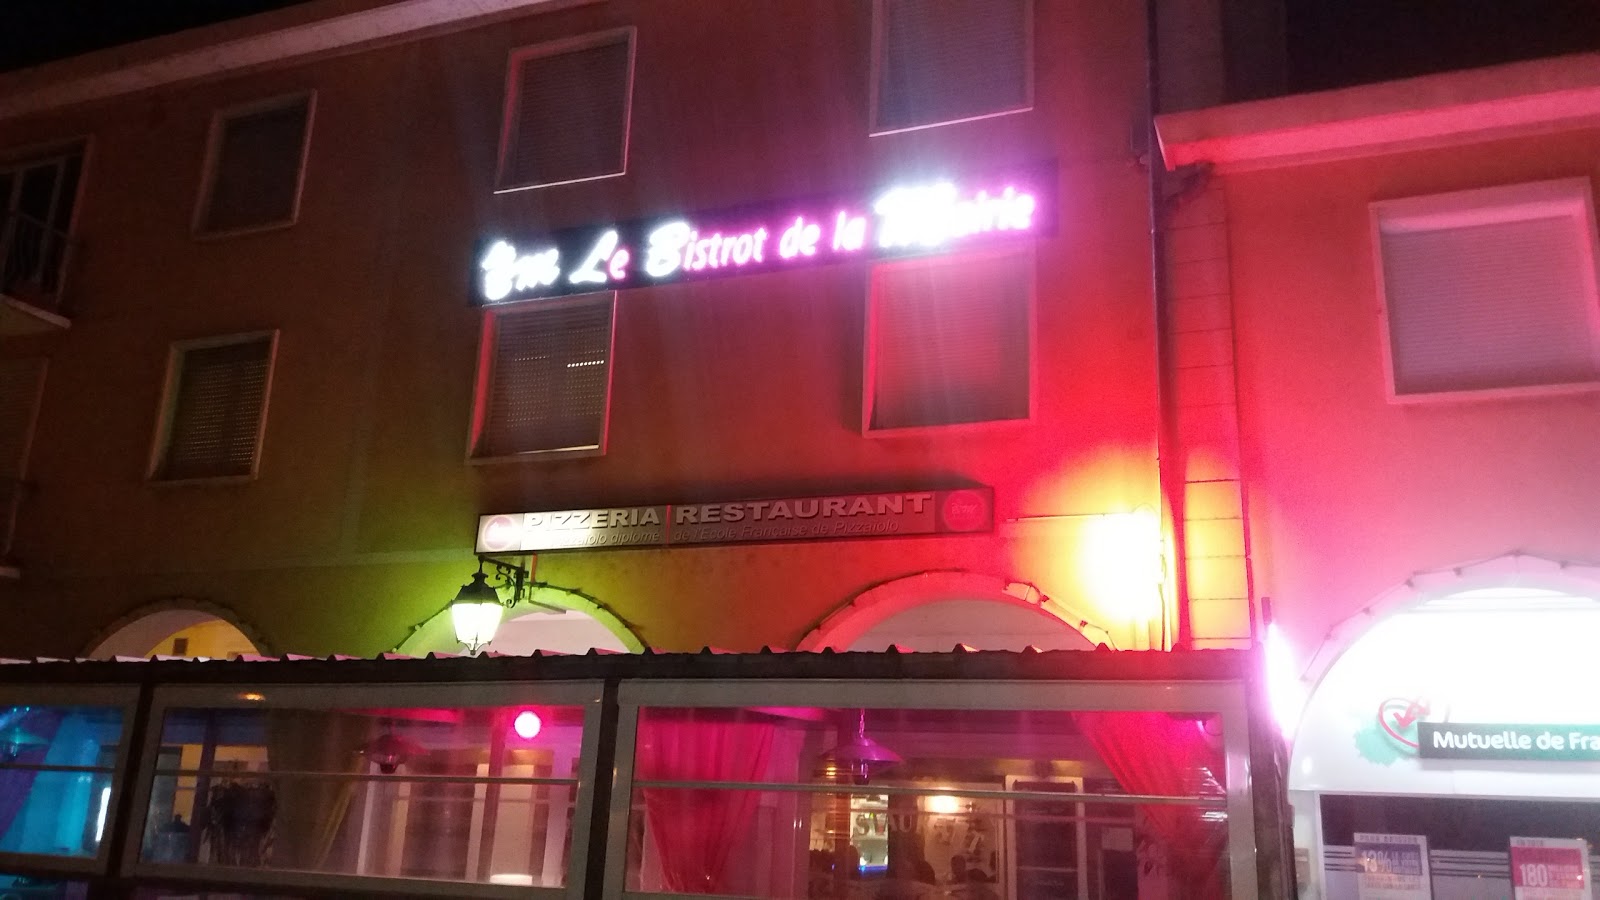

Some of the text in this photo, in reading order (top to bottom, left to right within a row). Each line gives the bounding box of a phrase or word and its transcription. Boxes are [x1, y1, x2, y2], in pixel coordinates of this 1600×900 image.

[569, 230, 630, 284] Le
[647, 221, 768, 278] Bistrot
[779, 216, 821, 259] de
[832, 210, 867, 251] la
[526, 507, 660, 532] PIZZERIA
[675, 494, 931, 525] RESTAURANT
[673, 529, 690, 541] de
[811, 520, 829, 535] de
[833, 518, 899, 537] Pizzaiolo
[1433, 731, 1600, 751] Mutuelle de Fra
[1519, 863, 1549, 888] 180
